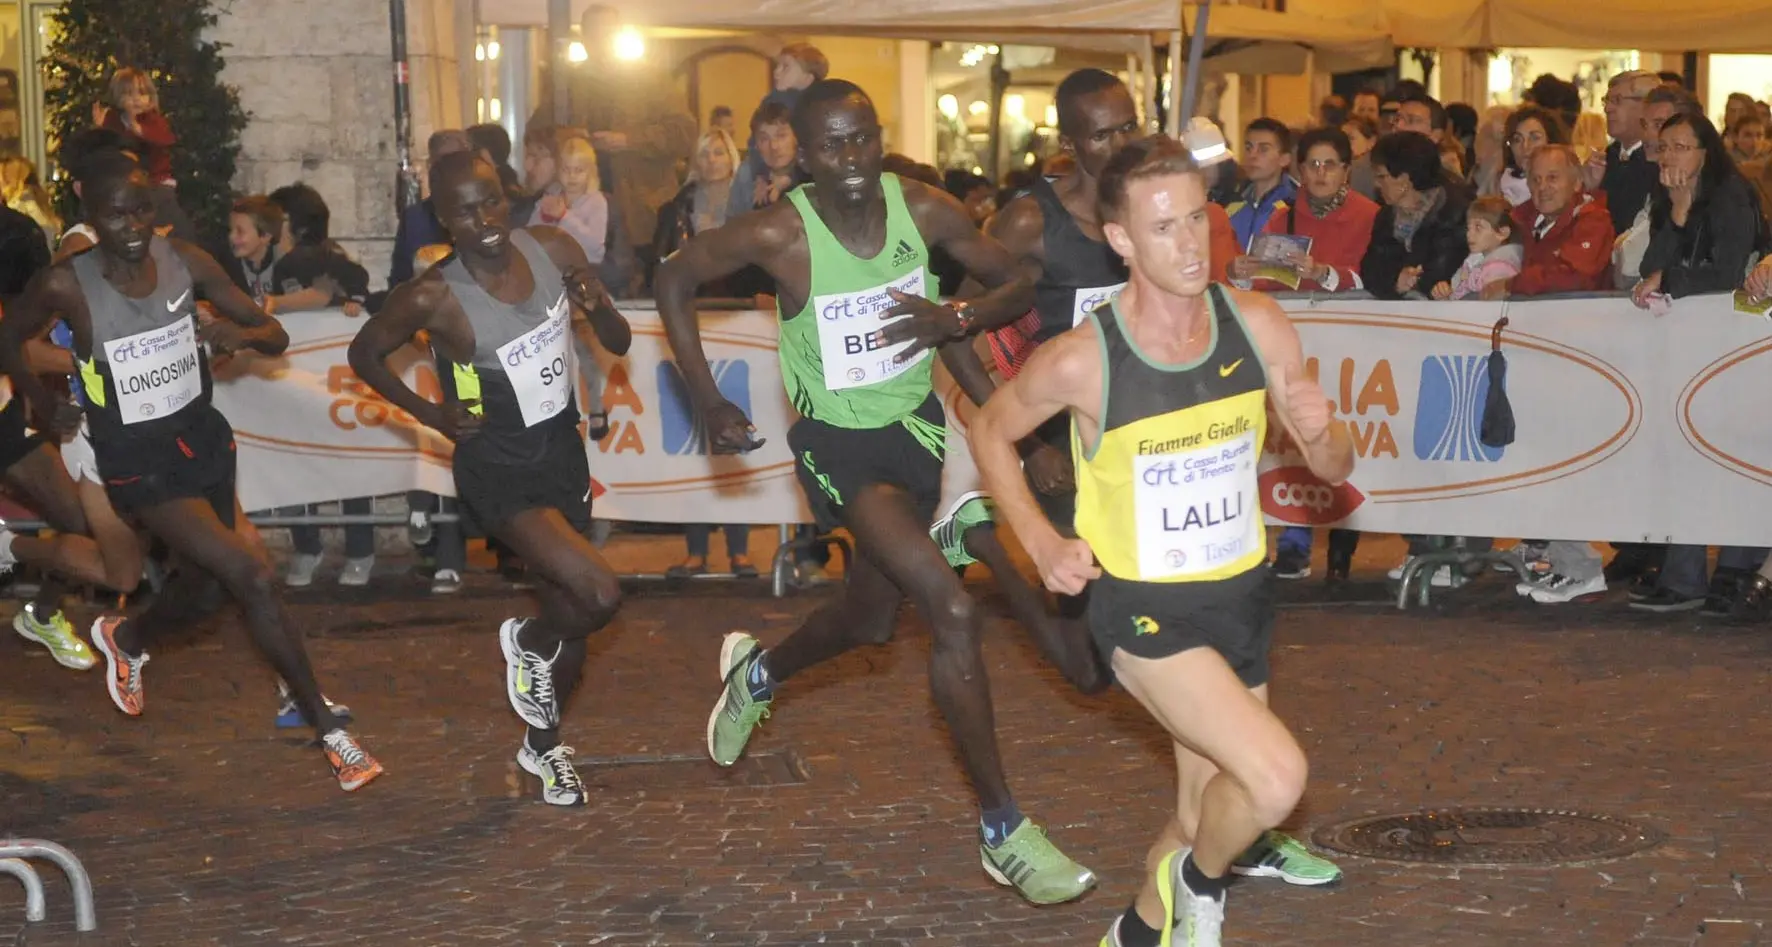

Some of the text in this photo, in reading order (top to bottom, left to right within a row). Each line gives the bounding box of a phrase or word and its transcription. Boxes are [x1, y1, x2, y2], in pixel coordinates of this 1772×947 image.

[891, 252, 918, 268] adidas
[856, 291, 888, 306] Cassa
[857, 306, 868, 316] di
[141, 347, 150, 356] di
[119, 352, 197, 395] LONGOSIWA
[1138, 415, 1250, 456] Fiamme Gialle
[1183, 461, 1237, 483] di Trento
[1272, 482, 1335, 514] coop
[1162, 491, 1242, 532] LALLI
